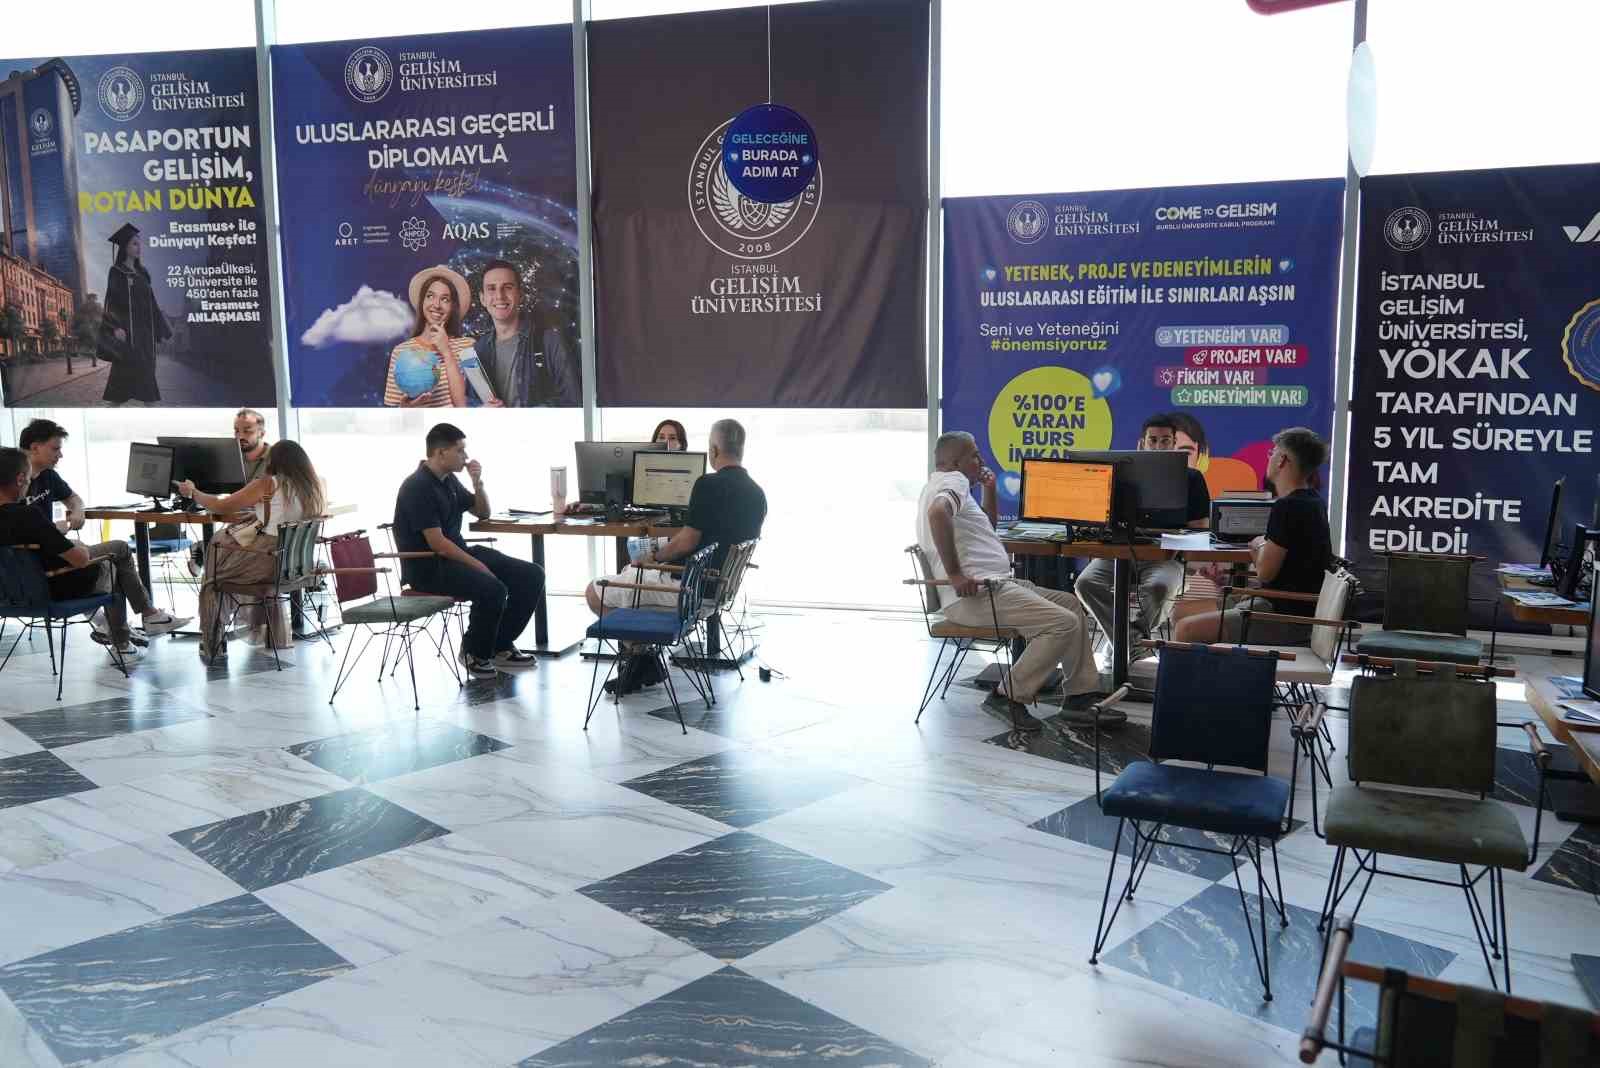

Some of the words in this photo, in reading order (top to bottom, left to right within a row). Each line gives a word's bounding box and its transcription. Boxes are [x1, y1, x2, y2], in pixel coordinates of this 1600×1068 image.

[399, 58, 461, 77] GELİŞİM
[151, 80, 210, 97] GELİŞİM
[400, 70, 497, 91] ÜNİVERSİTESİ
[152, 92, 245, 111] ÜNİVERSİTESİ
[296, 116, 456, 144] ULUSLARARASI
[461, 105, 554, 139] GEÇERLİ
[84, 125, 251, 154] PASAPORTUN
[732, 132, 808, 145] GELECEĞİNE
[368, 143, 509, 169] DİPLOMAYLA
[742, 149, 798, 161] BURADA
[143, 151, 253, 187] GELİŞİM,
[742, 166, 778, 177] ADIM
[782, 166, 799, 177] AT
[78, 189, 162, 215] ROTAN
[169, 183, 256, 211] DÜNYA
[1055, 210, 1109, 225] GELİŞİM
[1155, 206, 1202, 221] COME
[169, 221, 236, 233] Erasmus+
[238, 219, 256, 231] ile
[442, 222, 490, 241] AQAS
[1055, 220, 1140, 236] ÜNİVERSİTESİ
[1438, 218, 1498, 233] GELİŞİM
[149, 233, 205, 250] Dünyayı
[207, 233, 257, 249] Keşfet!
[1438, 228, 1534, 244] ÜNİVERSİTESİ
[738, 242, 773, 253] 2008
[167, 265, 182, 276] 22
[1005, 264, 1074, 283] YETENEK,
[1078, 262, 1127, 279] PROJE
[167, 277, 185, 288] 195
[187, 275, 242, 288] Üniversite
[244, 276, 258, 286] ile
[710, 274, 802, 298] GELİŞİM
[1381, 271, 1485, 291] İSTANBUL
[232, 287, 259, 298] fazla
[980, 288, 1085, 306] ULUSLARARASI
[1087, 284, 1138, 305] EĞİTİM
[1141, 286, 1163, 304] İLE
[1168, 286, 1244, 303] SINIRLARI
[1247, 285, 1295, 306] AŞSIN
[201, 300, 259, 311] Erasmus+
[690, 292, 823, 314] ÜNİVERSİTESİ
[1380, 294, 1464, 319] GELİŞİM
[980, 322, 1012, 336] Seni
[1016, 325, 1033, 336] ve
[1037, 321, 1119, 339] Yeteneğini
[1174, 325, 1245, 344] YETENEĞİM
[1251, 328, 1282, 343] VAR!
[1378, 318, 1528, 341] ÜNİVERSİTESİ,
[991, 337, 1107, 353] #önemsiyoruz
[1210, 349, 1261, 364] PROJEM
[1265, 348, 1297, 364] VAR!
[1378, 340, 1533, 379] YÖKAK
[1177, 367, 1219, 385] FİKRİM
[1224, 370, 1254, 385] VAR!
[1194, 386, 1266, 404] DENEYİMİM
[1271, 389, 1302, 405] VAR!
[1376, 391, 1577, 416] TARAFINDAN
[1012, 413, 1086, 429] VARAN
[1023, 431, 1075, 446] BURS
[1373, 426, 1392, 448] 5
[1400, 427, 1444, 449] YIL
[1452, 422, 1593, 453] SÜREYLE
[1372, 461, 1439, 484] TAM
[1370, 492, 1522, 522] AKREDİTE
[1369, 524, 1469, 554] EDİLDİ!
